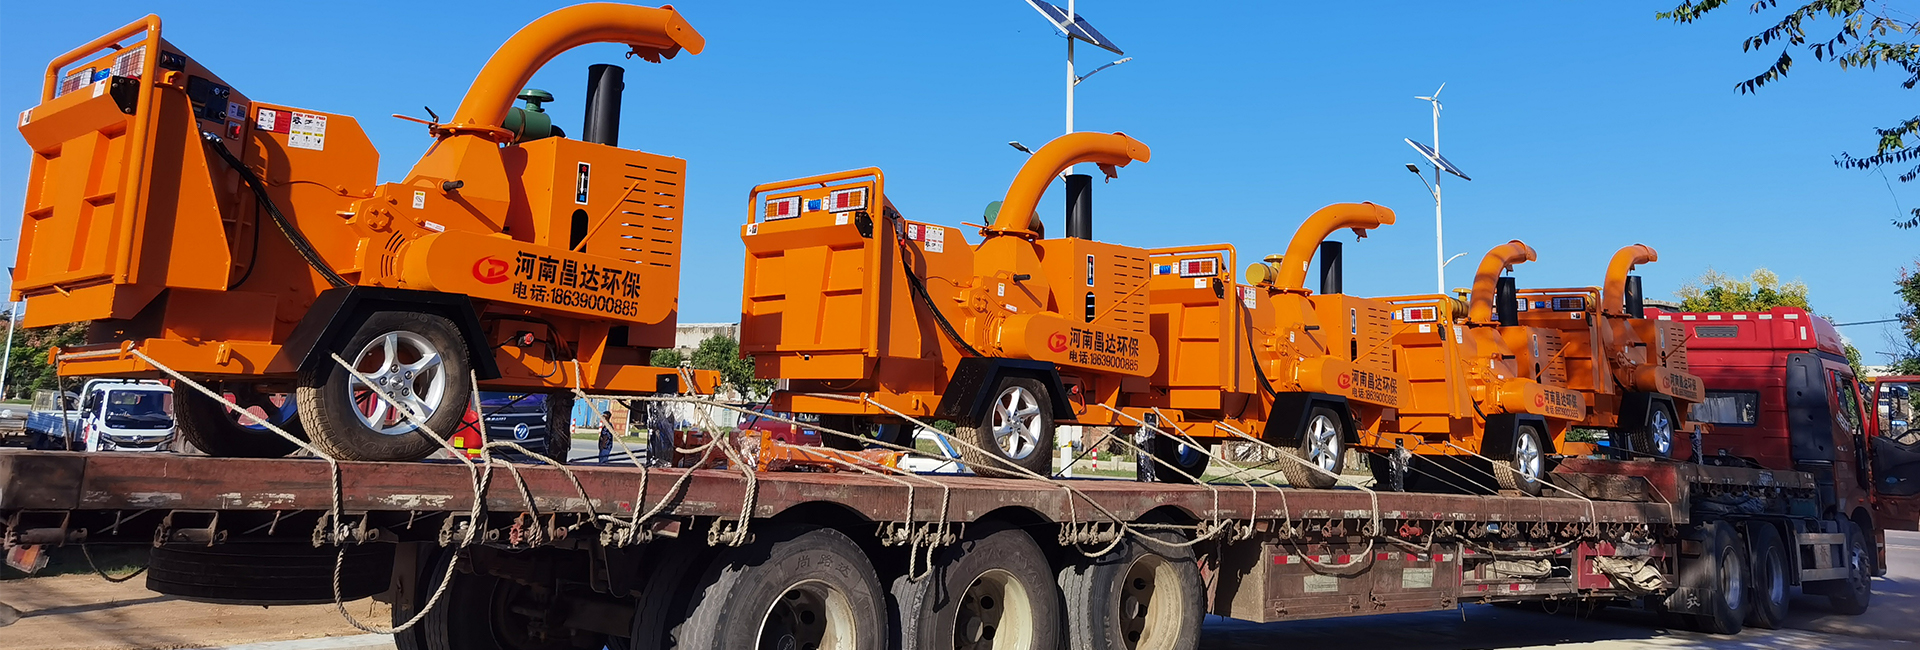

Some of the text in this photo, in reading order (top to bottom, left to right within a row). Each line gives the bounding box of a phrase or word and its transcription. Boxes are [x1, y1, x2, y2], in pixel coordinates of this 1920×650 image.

[514, 250, 641, 299] 河南昌达环保
[512, 281, 639, 317] 电话:18639000885
[1069, 327, 1139, 357] 河南昌达环保
